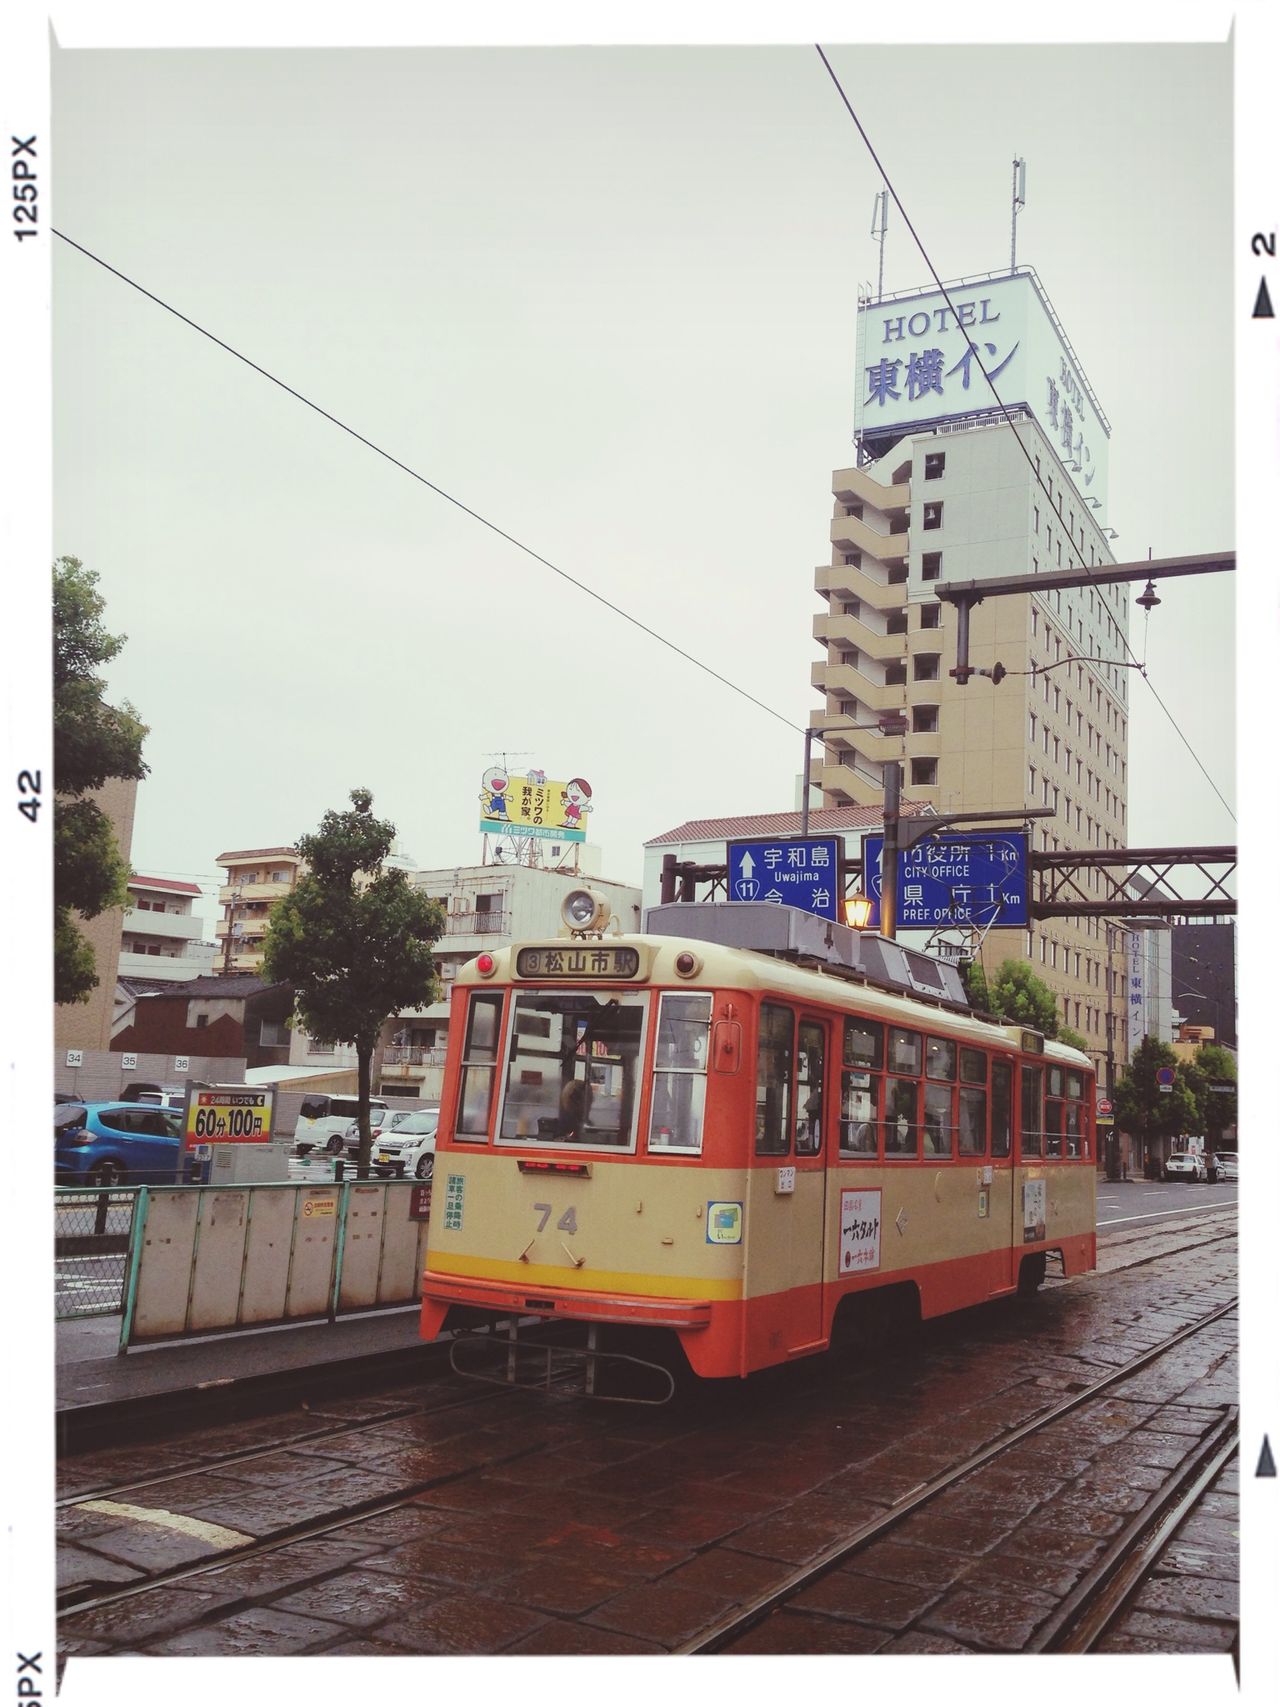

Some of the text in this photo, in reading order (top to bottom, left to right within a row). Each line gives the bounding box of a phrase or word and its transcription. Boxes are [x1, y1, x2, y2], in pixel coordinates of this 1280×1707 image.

[882, 298, 1001, 344] HOTEL
[863, 340, 1021, 407] 東横イン
[533, 788, 545, 825] ミツワの
[764, 846, 830, 869] 宇和島
[774, 870, 819, 884] Uwajima
[904, 865, 970, 878] CITY OFFICE
[740, 882, 754, 897] 11
[903, 908, 972, 920] PREF. OFFICE
[545, 951, 634, 973] 松山市駅
[1131, 933, 1140, 974] HOTEL
[1130, 977, 1142, 1037] 東横イン
[68, 1054, 81, 1063] 34
[123, 1056, 136, 1066] 35
[175, 1059, 188, 1068] 36
[533, 1202, 578, 1235] 74
